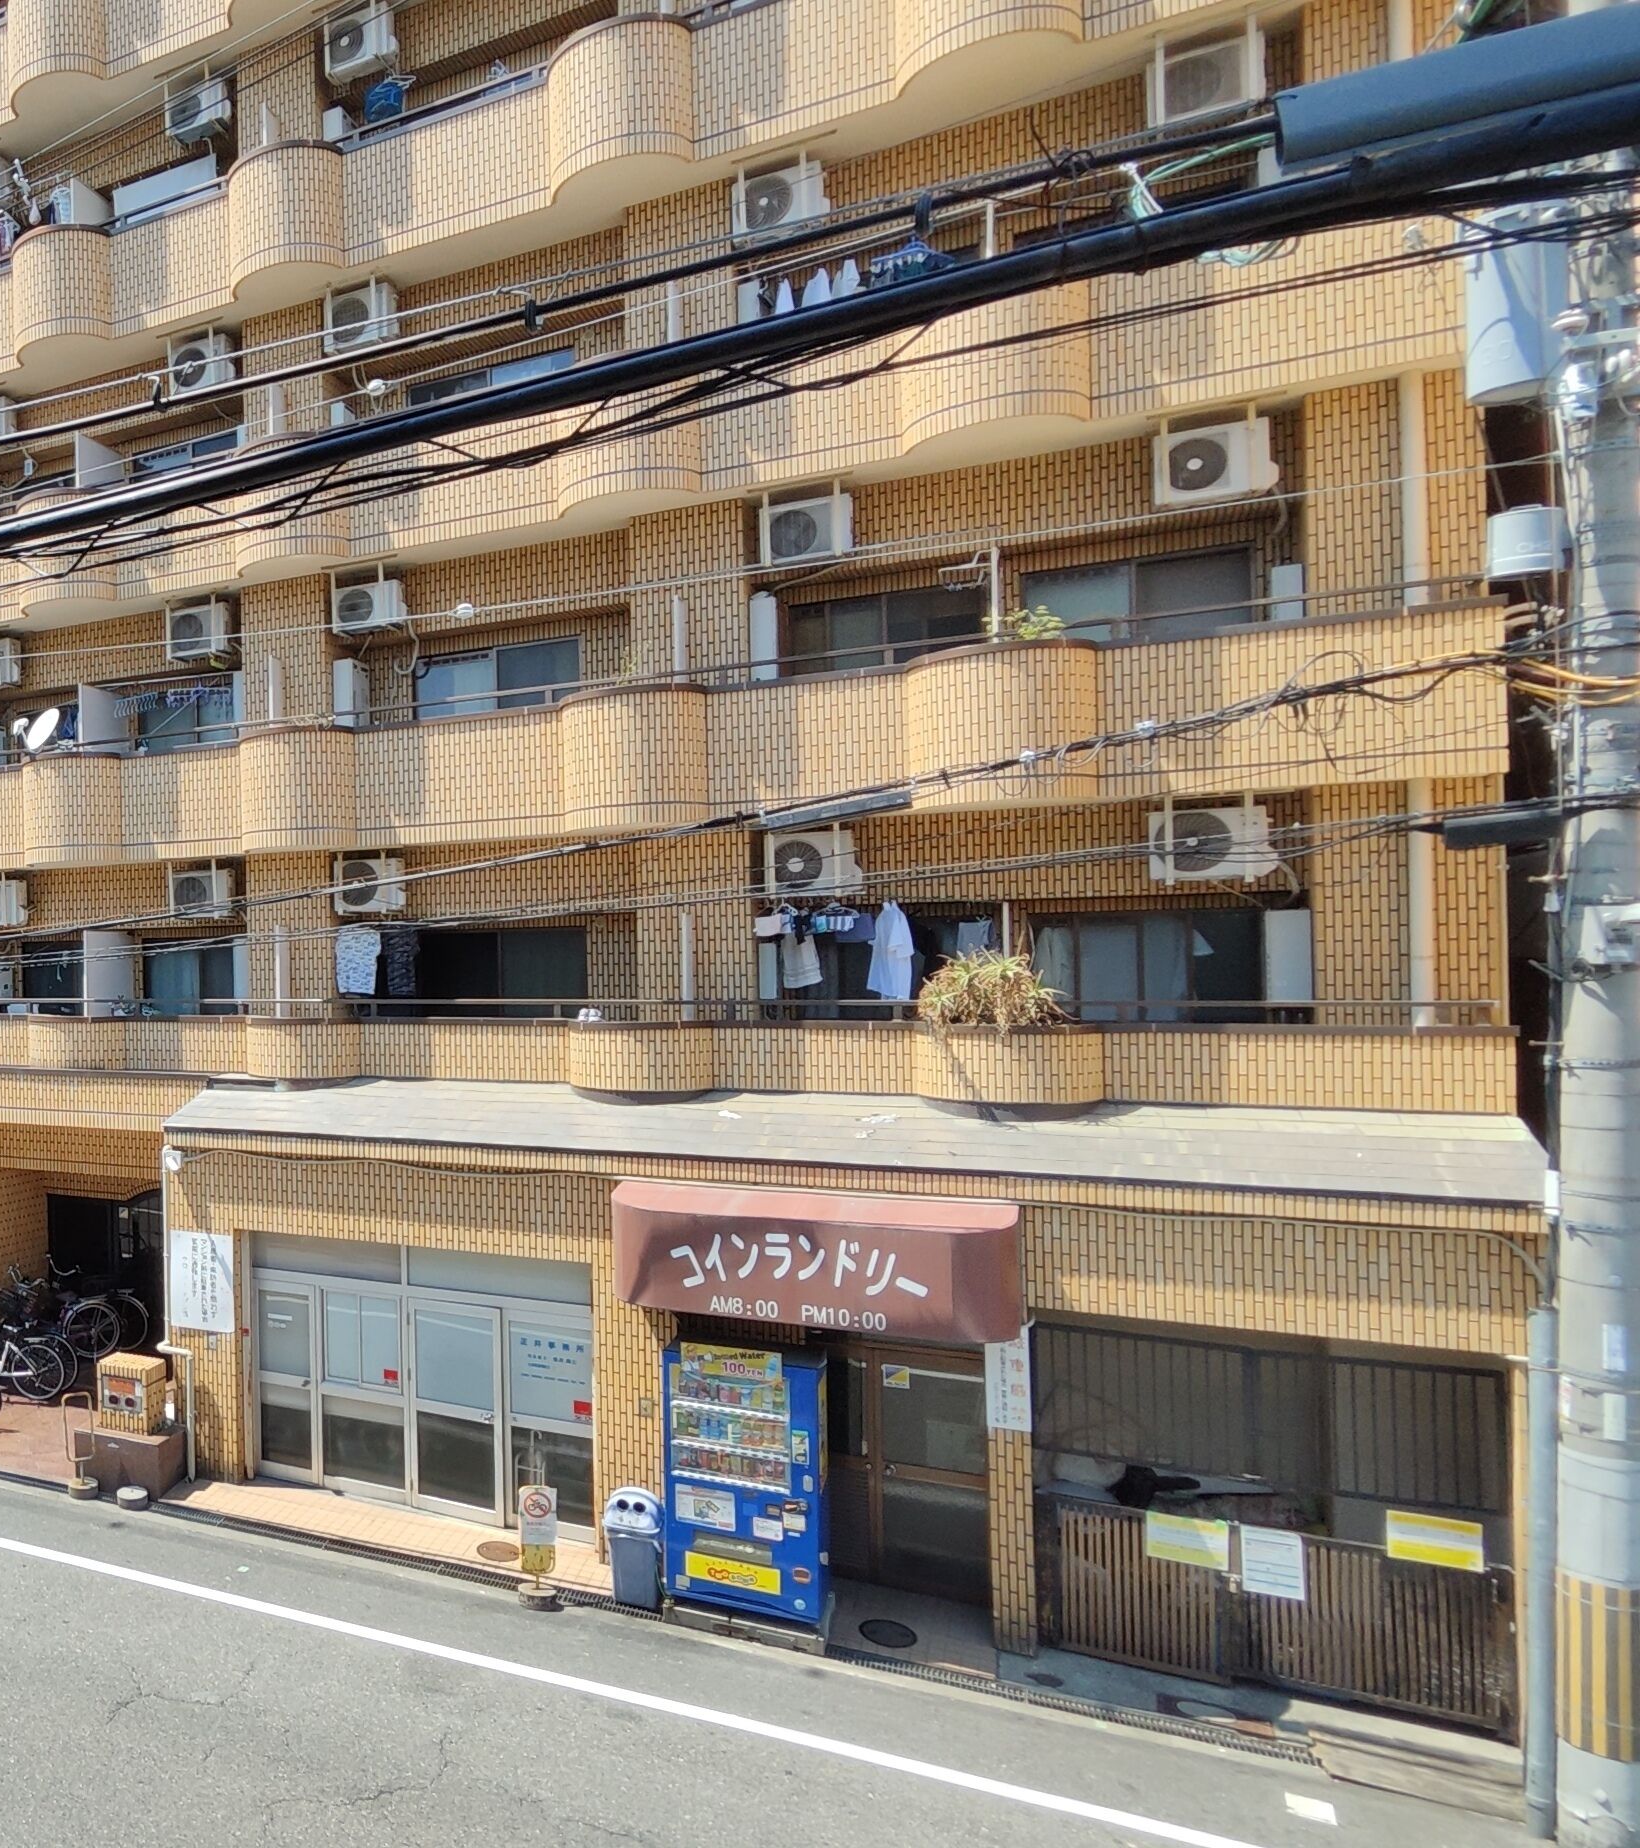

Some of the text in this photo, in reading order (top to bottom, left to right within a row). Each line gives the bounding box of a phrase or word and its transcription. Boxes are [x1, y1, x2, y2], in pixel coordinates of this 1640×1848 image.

[670, 1232, 929, 1298] コインランドリー
[710, 1295, 887, 1332] AM8:00 PM10:00
